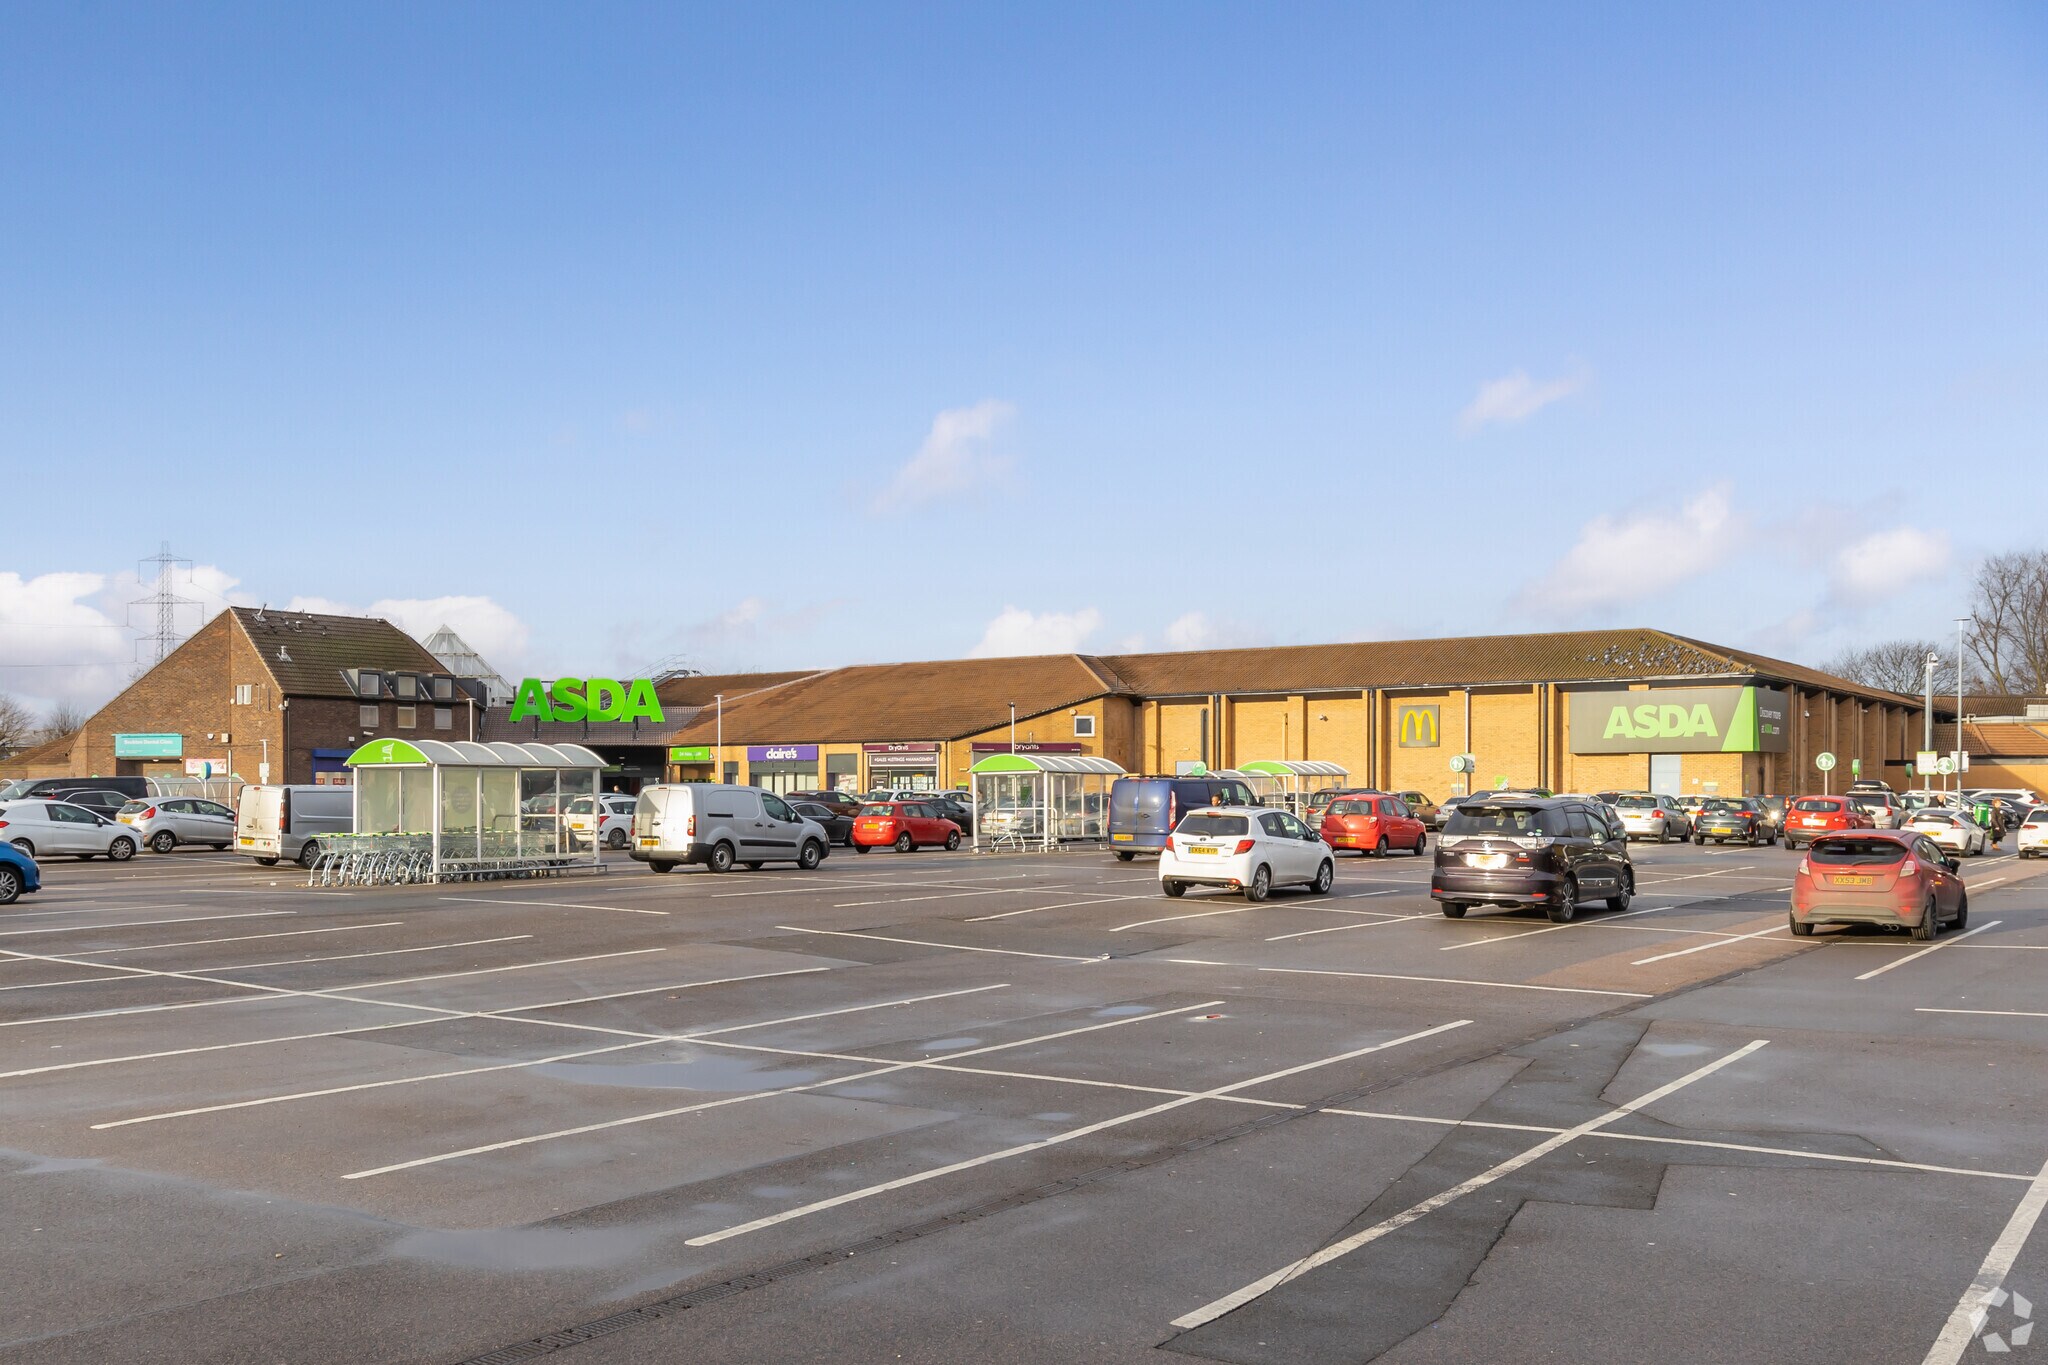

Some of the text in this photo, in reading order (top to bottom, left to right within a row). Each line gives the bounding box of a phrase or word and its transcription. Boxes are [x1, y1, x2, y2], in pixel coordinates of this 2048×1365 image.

[509, 677, 666, 723] ASDA
[1759, 706, 1772, 719] Discover
[1602, 703, 1719, 739] ASDA
[766, 747, 798, 760] claire's
[1014, 743, 1040, 751] bryants
